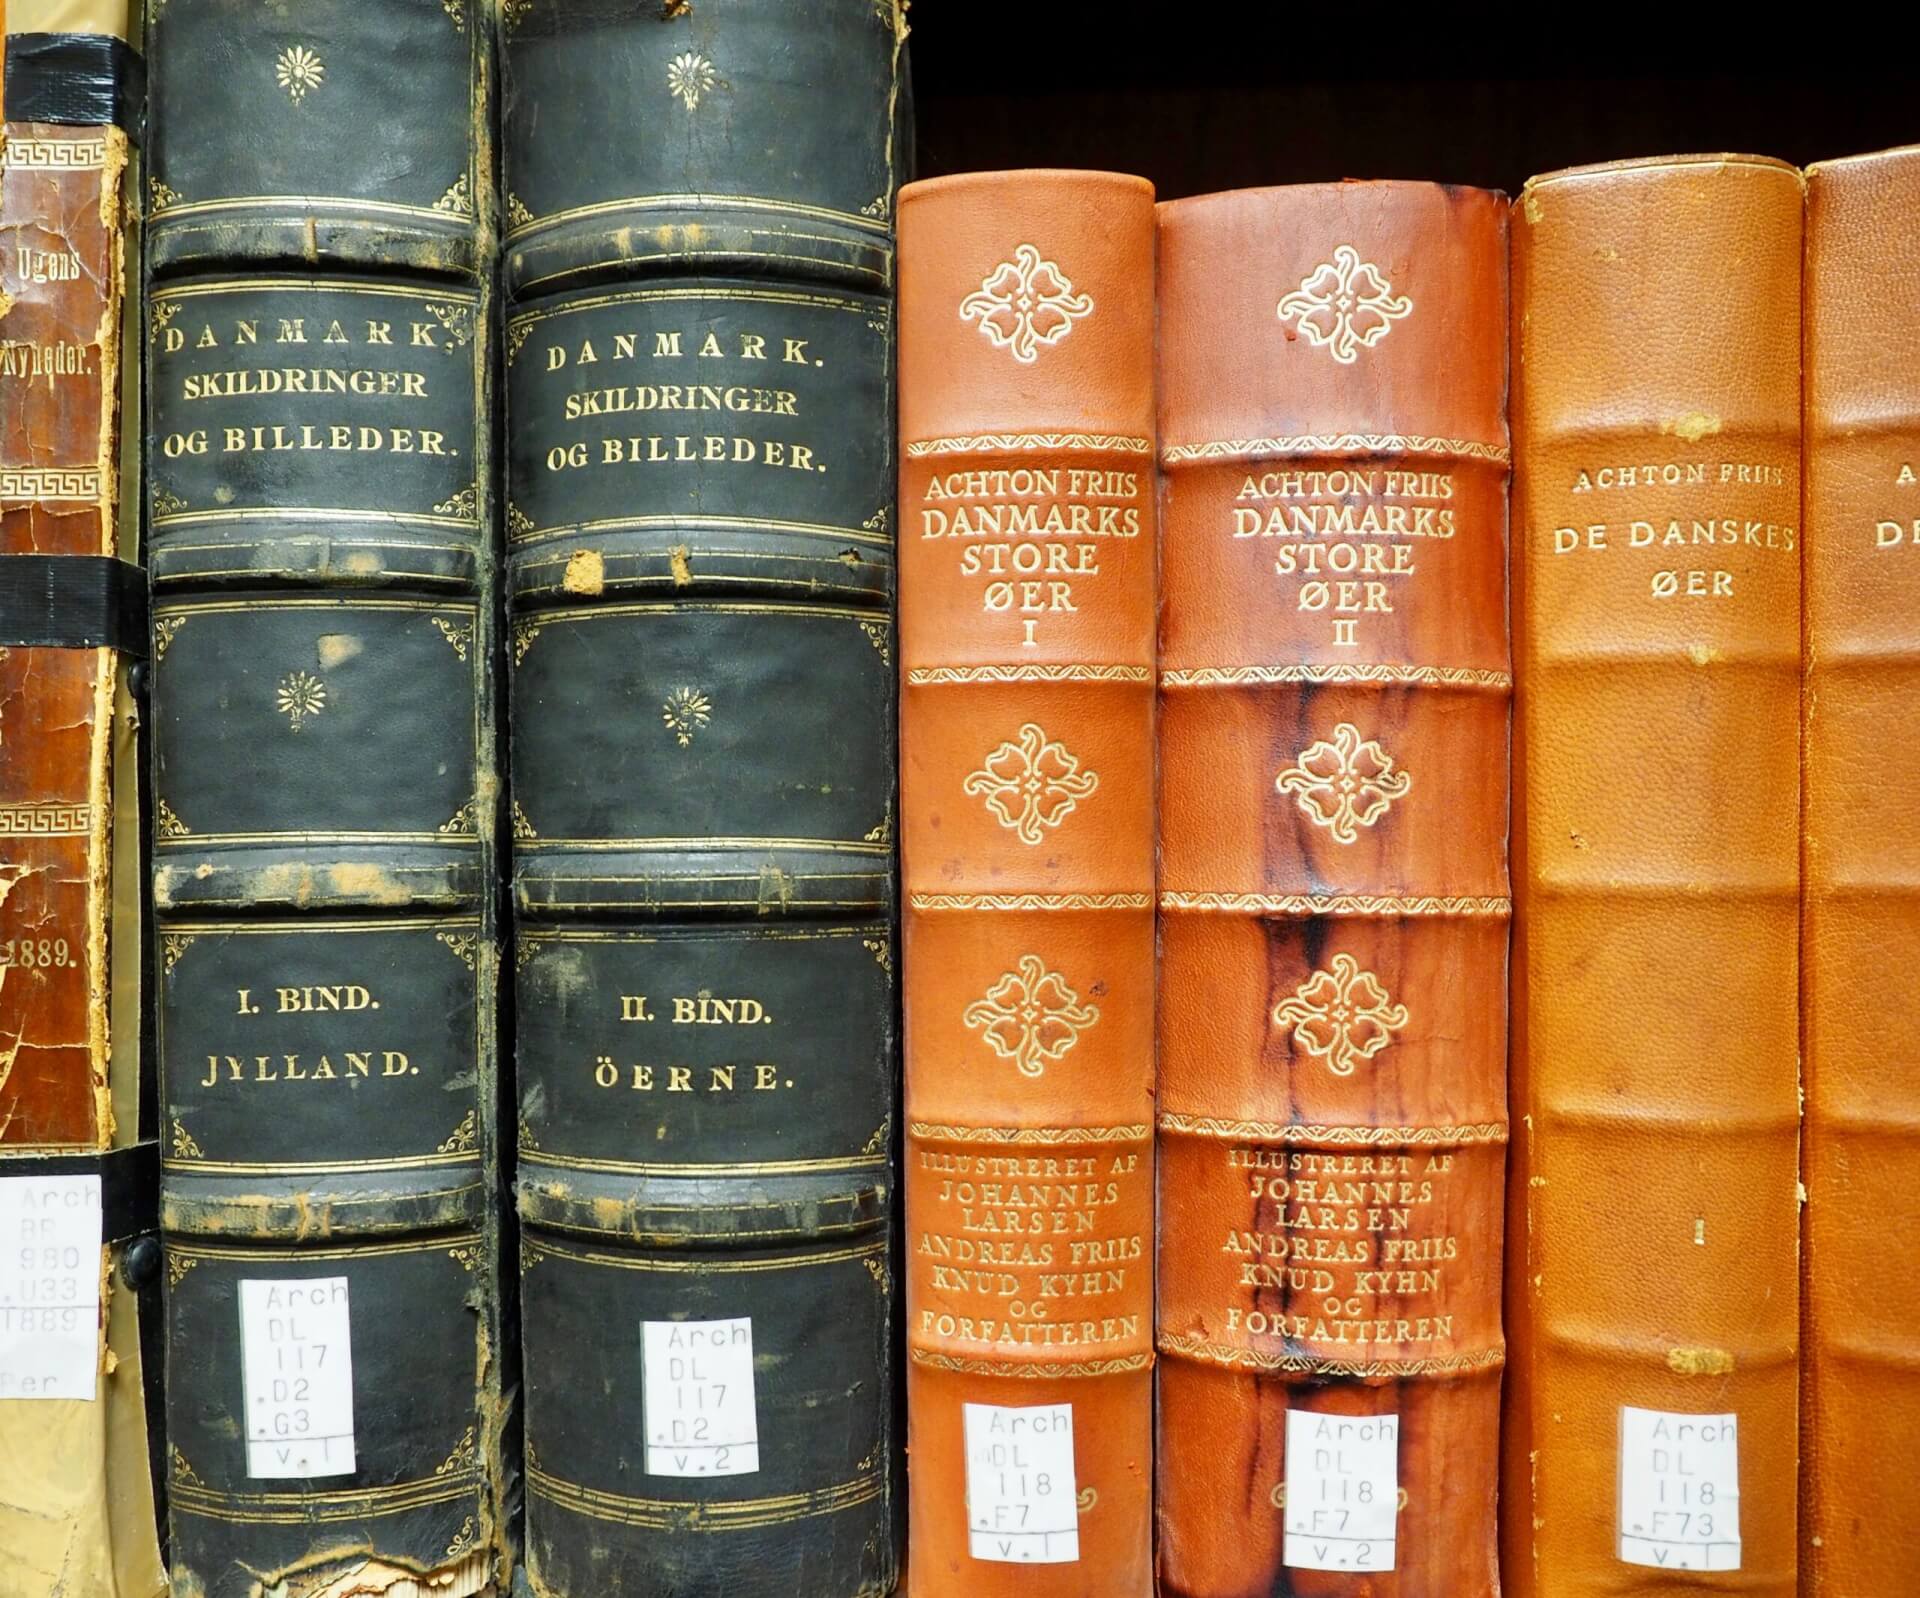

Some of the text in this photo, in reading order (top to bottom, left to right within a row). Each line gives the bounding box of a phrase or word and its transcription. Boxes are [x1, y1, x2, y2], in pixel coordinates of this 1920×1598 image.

[17, 247, 80, 284] Ugens
[164, 319, 456, 354] DANMARK.
[546, 332, 824, 371] DANMARK.
[184, 368, 428, 400] SKILDRINGER
[564, 386, 799, 420] SKILDRINGER
[163, 425, 459, 458] OG BILLEDER.
[546, 436, 827, 473] OG BILLEDER.
[924, 469, 1138, 500] ACHTON FRIIS
[1236, 470, 1453, 500] ACHTON FRIIS
[1572, 463, 1783, 492] ACHTON FRIIS
[921, 504, 1140, 539] DANMARKS
[1233, 504, 1455, 539] DANMARKS
[1554, 520, 1795, 553] DE DANSKES
[960, 543, 1099, 576] STORE
[1275, 543, 1415, 576] STORE
[983, 581, 1078, 612] ØER
[1297, 581, 1394, 612] ØER
[1651, 570, 1734, 597] ØER
[1022, 619, 1038, 646] I
[1331, 619, 1359, 646] II
[6, 938, 77, 968] 1889.
[237, 985, 381, 1014] I. BIND.
[620, 996, 773, 1024] II. BIND.
[201, 1052, 420, 1087] JYLLAND.
[595, 1056, 794, 1091] ÖERNE.
[920, 1151, 1138, 1177] ILLUSTRERET AF
[1228, 1149, 1454, 1175] ILLUSTRERET AF
[21, 1183, 100, 1208] Arch
[939, 1180, 1119, 1207] JOHANNES
[1250, 1177, 1433, 1204] JOHANNES
[962, 1208, 1096, 1234] LARSEN
[1276, 1204, 1410, 1231] LARSEN
[20, 1246, 80, 1270] 980
[917, 1233, 1142, 1265] ANDREAS FRIIS
[1223, 1231, 1457, 1262] ANDREAS FRIIS
[932, 1265, 1125, 1297] KNUD KYHN
[1239, 1263, 1440, 1293] KNUD KYHN
[266, 1280, 348, 1309] Arch
[1323, 1297, 1363, 1315] OG
[4, 1308, 78, 1333] 1889
[1009, 1300, 1048, 1319] OG
[268, 1317, 307, 1342] DL
[668, 1323, 748, 1348] Arch
[921, 1311, 1139, 1346] FORFATTEREN
[1226, 1308, 1453, 1343] FORFATTEREN
[277, 1344, 328, 1370] 117
[670, 1357, 707, 1381] DL
[257, 1378, 309, 1402] .D2
[677, 1384, 727, 1409] 117
[258, 1409, 309, 1435] .G3
[657, 1417, 709, 1442] .D2
[989, 1410, 1068, 1434] Arch
[1315, 1417, 1394, 1441] Arch
[1652, 1417, 1736, 1442] Arch
[993, 1444, 1029, 1468] DL
[1315, 1449, 1352, 1474] DL
[1652, 1448, 1695, 1476] DL
[1000, 1472, 1052, 1497] 118
[1321, 1479, 1373, 1503] 118
[1660, 1480, 1715, 1505] 118
[980, 1504, 1029, 1529] .F7
[1296, 1510, 1350, 1532] .F7
[1633, 1511, 1714, 1537] .F73
